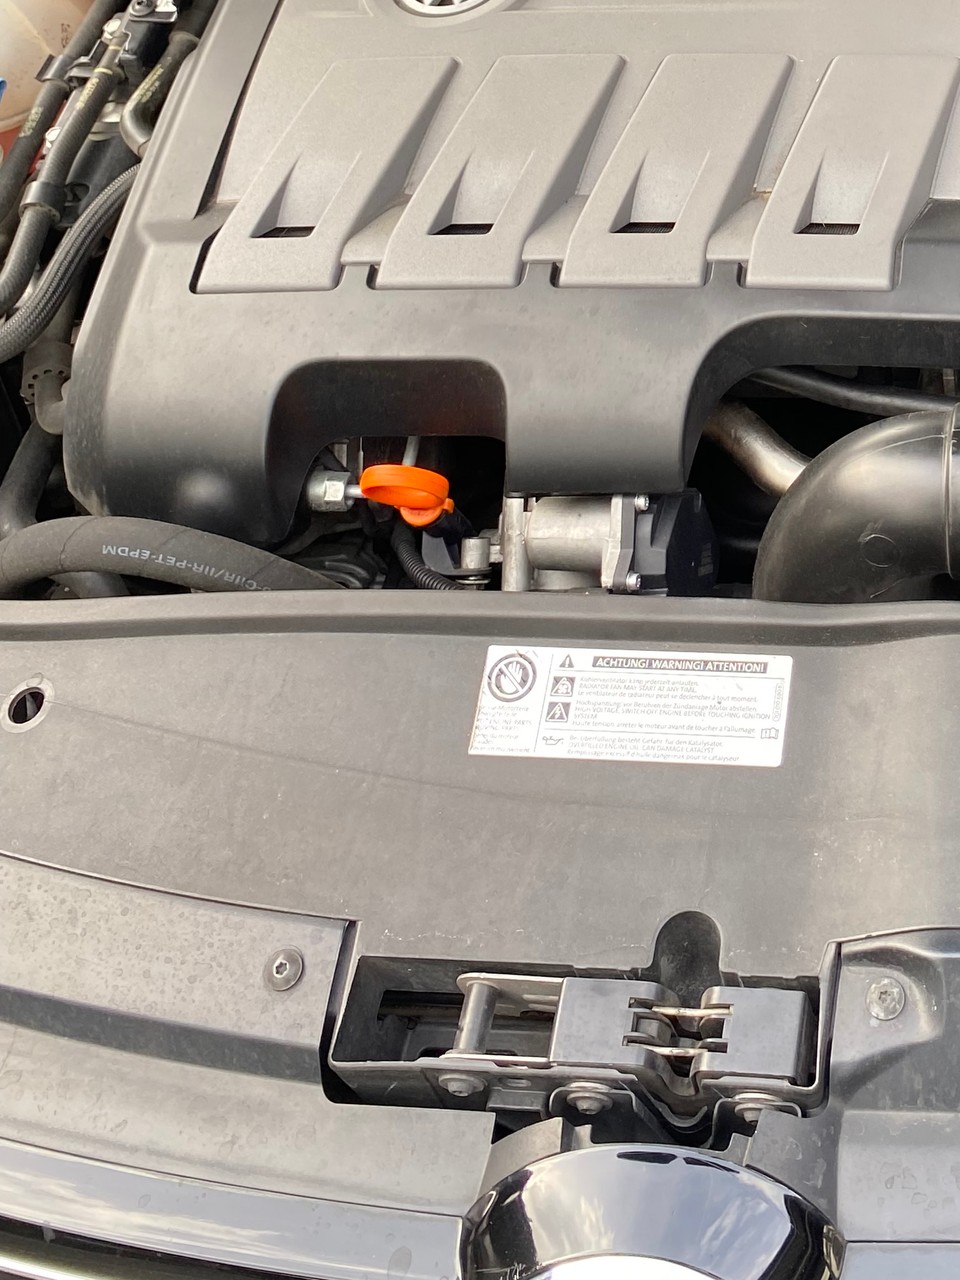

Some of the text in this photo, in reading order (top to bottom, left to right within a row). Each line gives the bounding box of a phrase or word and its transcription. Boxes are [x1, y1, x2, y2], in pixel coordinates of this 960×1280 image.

[596, 658, 764, 672] ACHTUNG! WARNING! ATTENTION!
